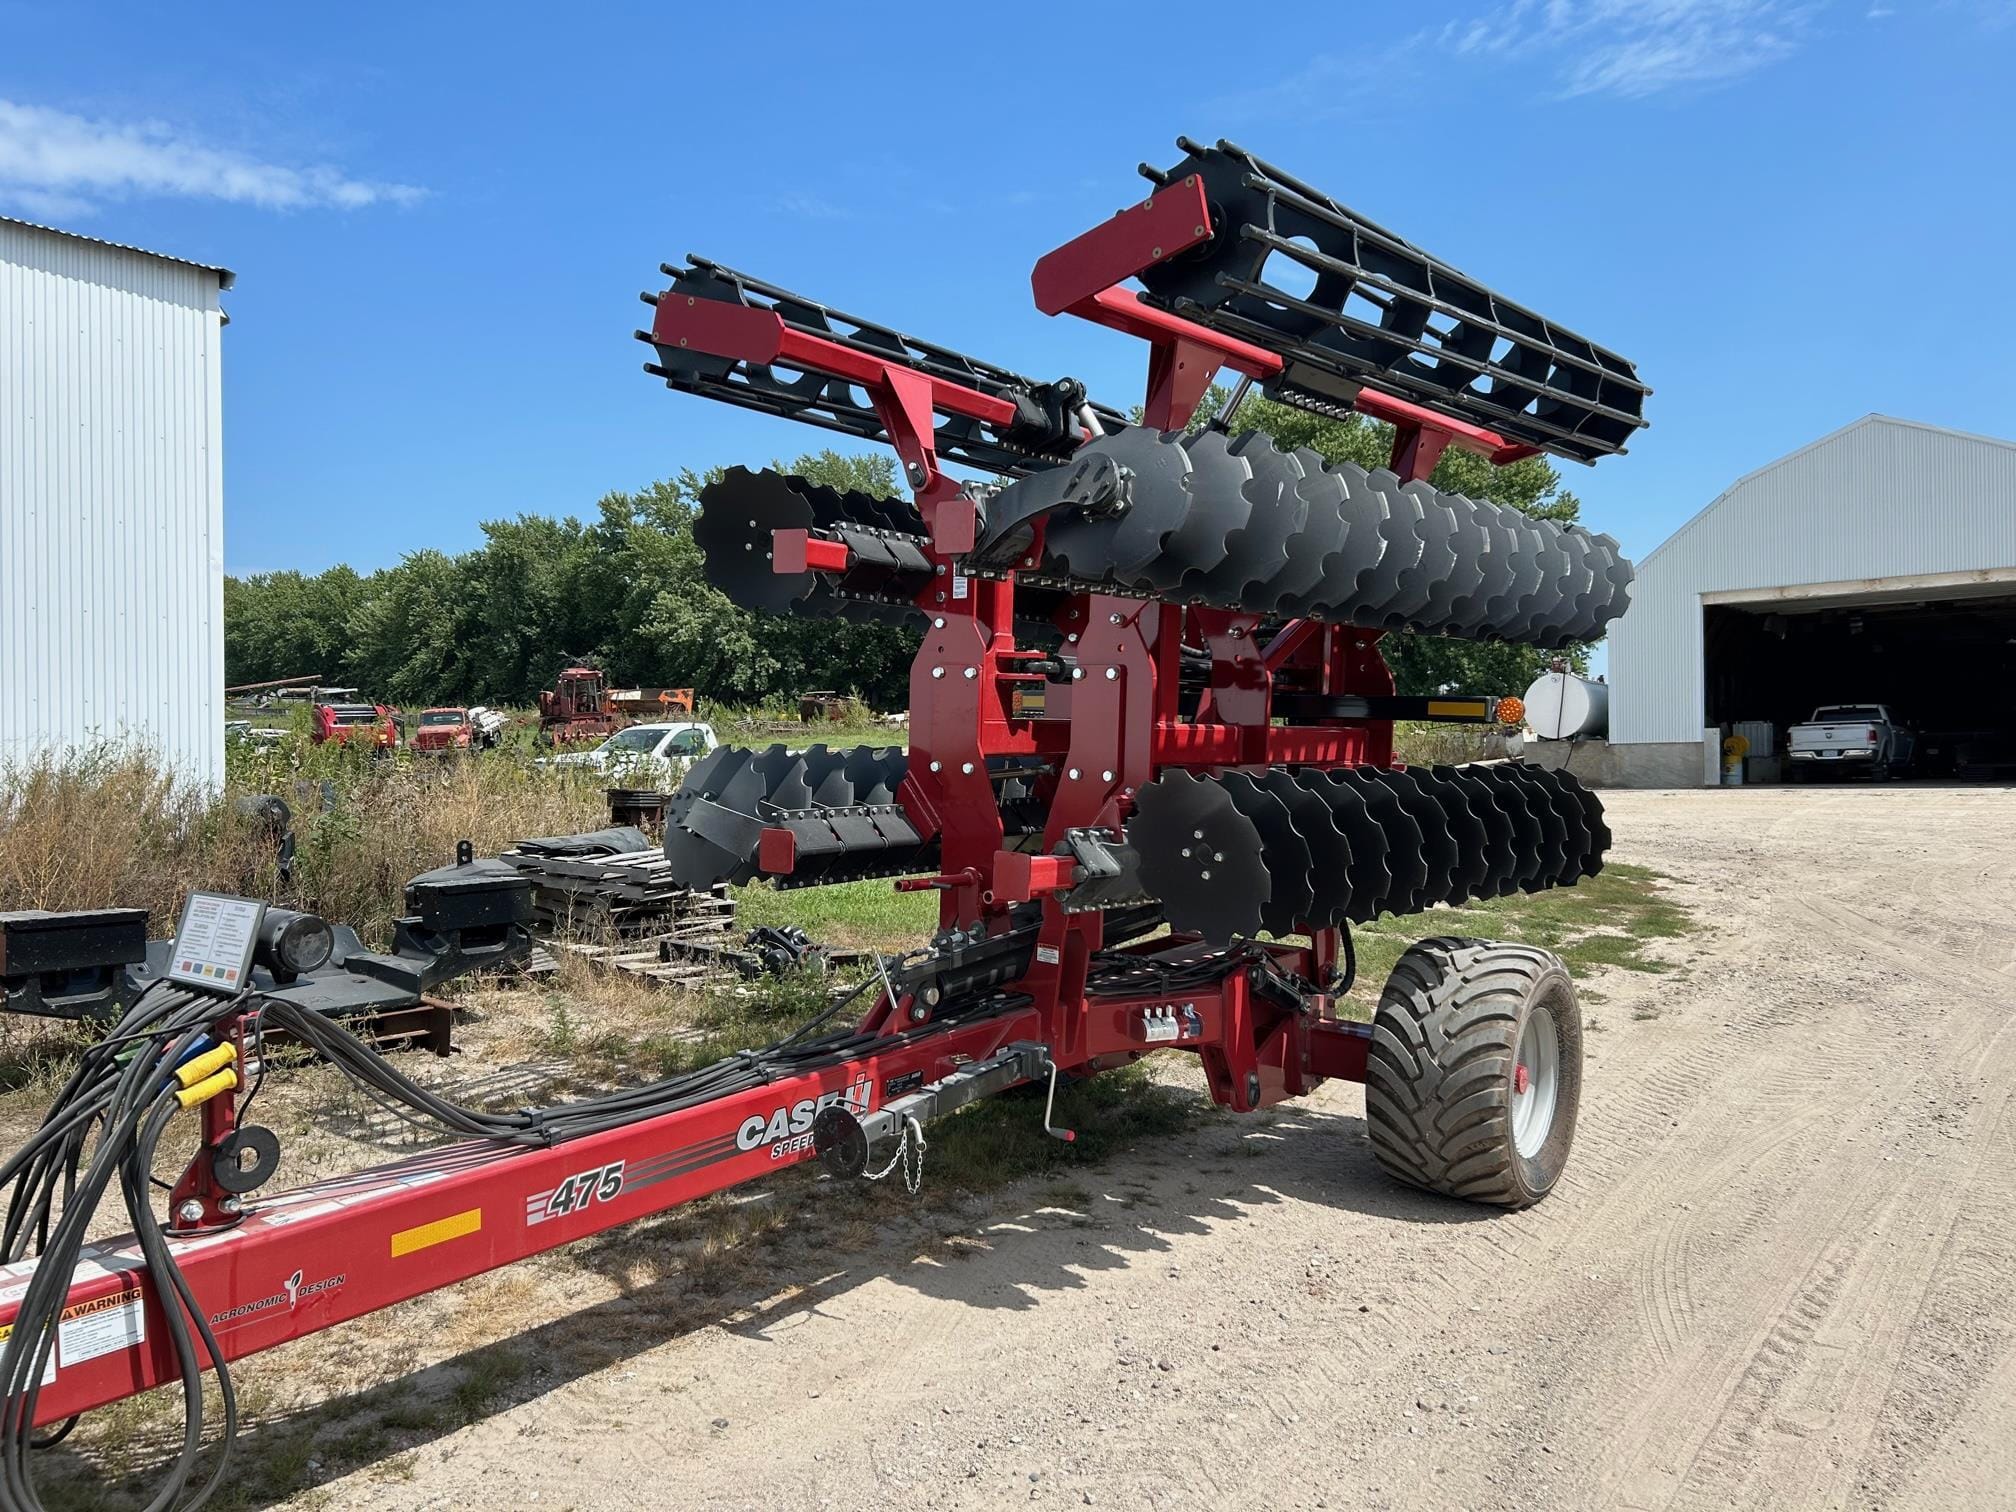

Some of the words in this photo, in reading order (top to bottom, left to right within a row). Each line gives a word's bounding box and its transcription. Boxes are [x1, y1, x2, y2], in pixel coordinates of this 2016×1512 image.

[546, 1159, 626, 1217] 475
[74, 1289, 141, 1317] WARNING
[209, 1293, 287, 1325] AGRONOMIC
[298, 1274, 346, 1297] DESIGN
